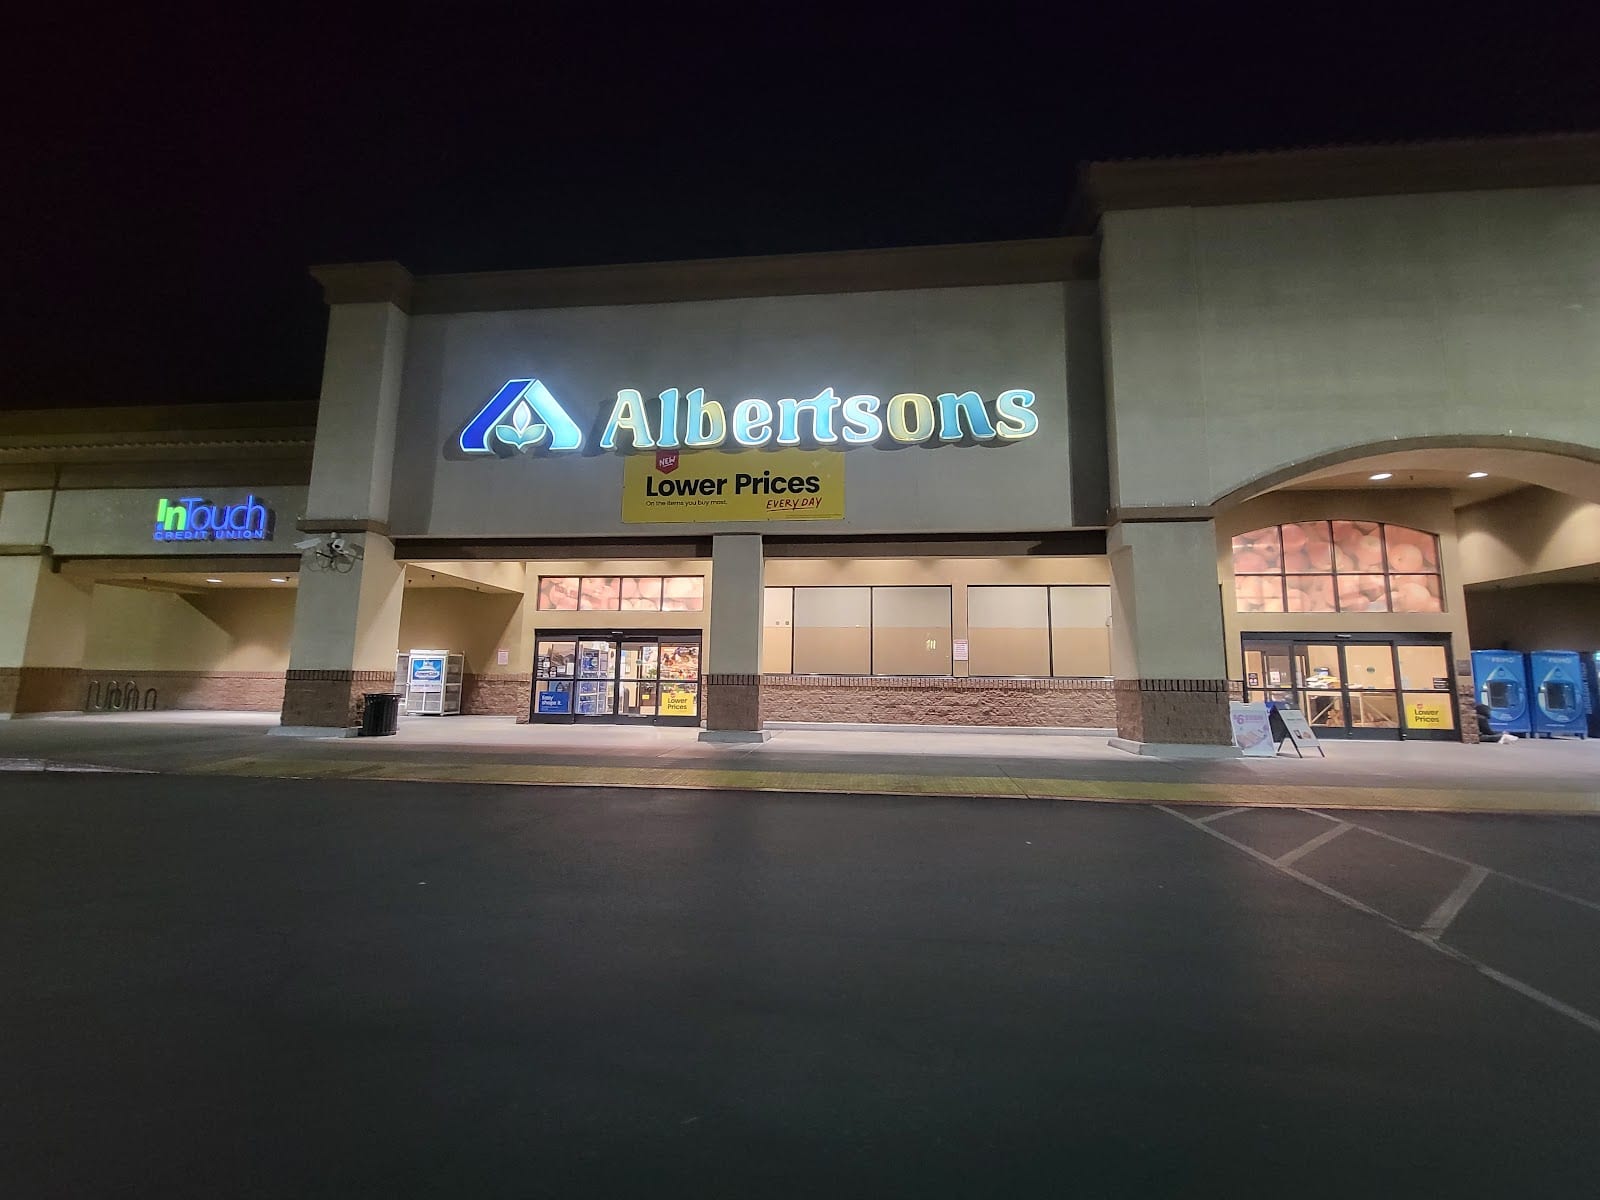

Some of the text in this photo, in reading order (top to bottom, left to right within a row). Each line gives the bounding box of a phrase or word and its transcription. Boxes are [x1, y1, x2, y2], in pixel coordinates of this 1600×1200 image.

[600, 387, 1039, 447] Albertsons
[658, 455, 677, 467] NEW
[646, 470, 820, 497] Lower Prices
[697, 499, 710, 507] buy
[766, 496, 823, 510] EVERY DAY
[156, 494, 266, 531] InTouch
[154, 529, 264, 541] CREDIT UNION
